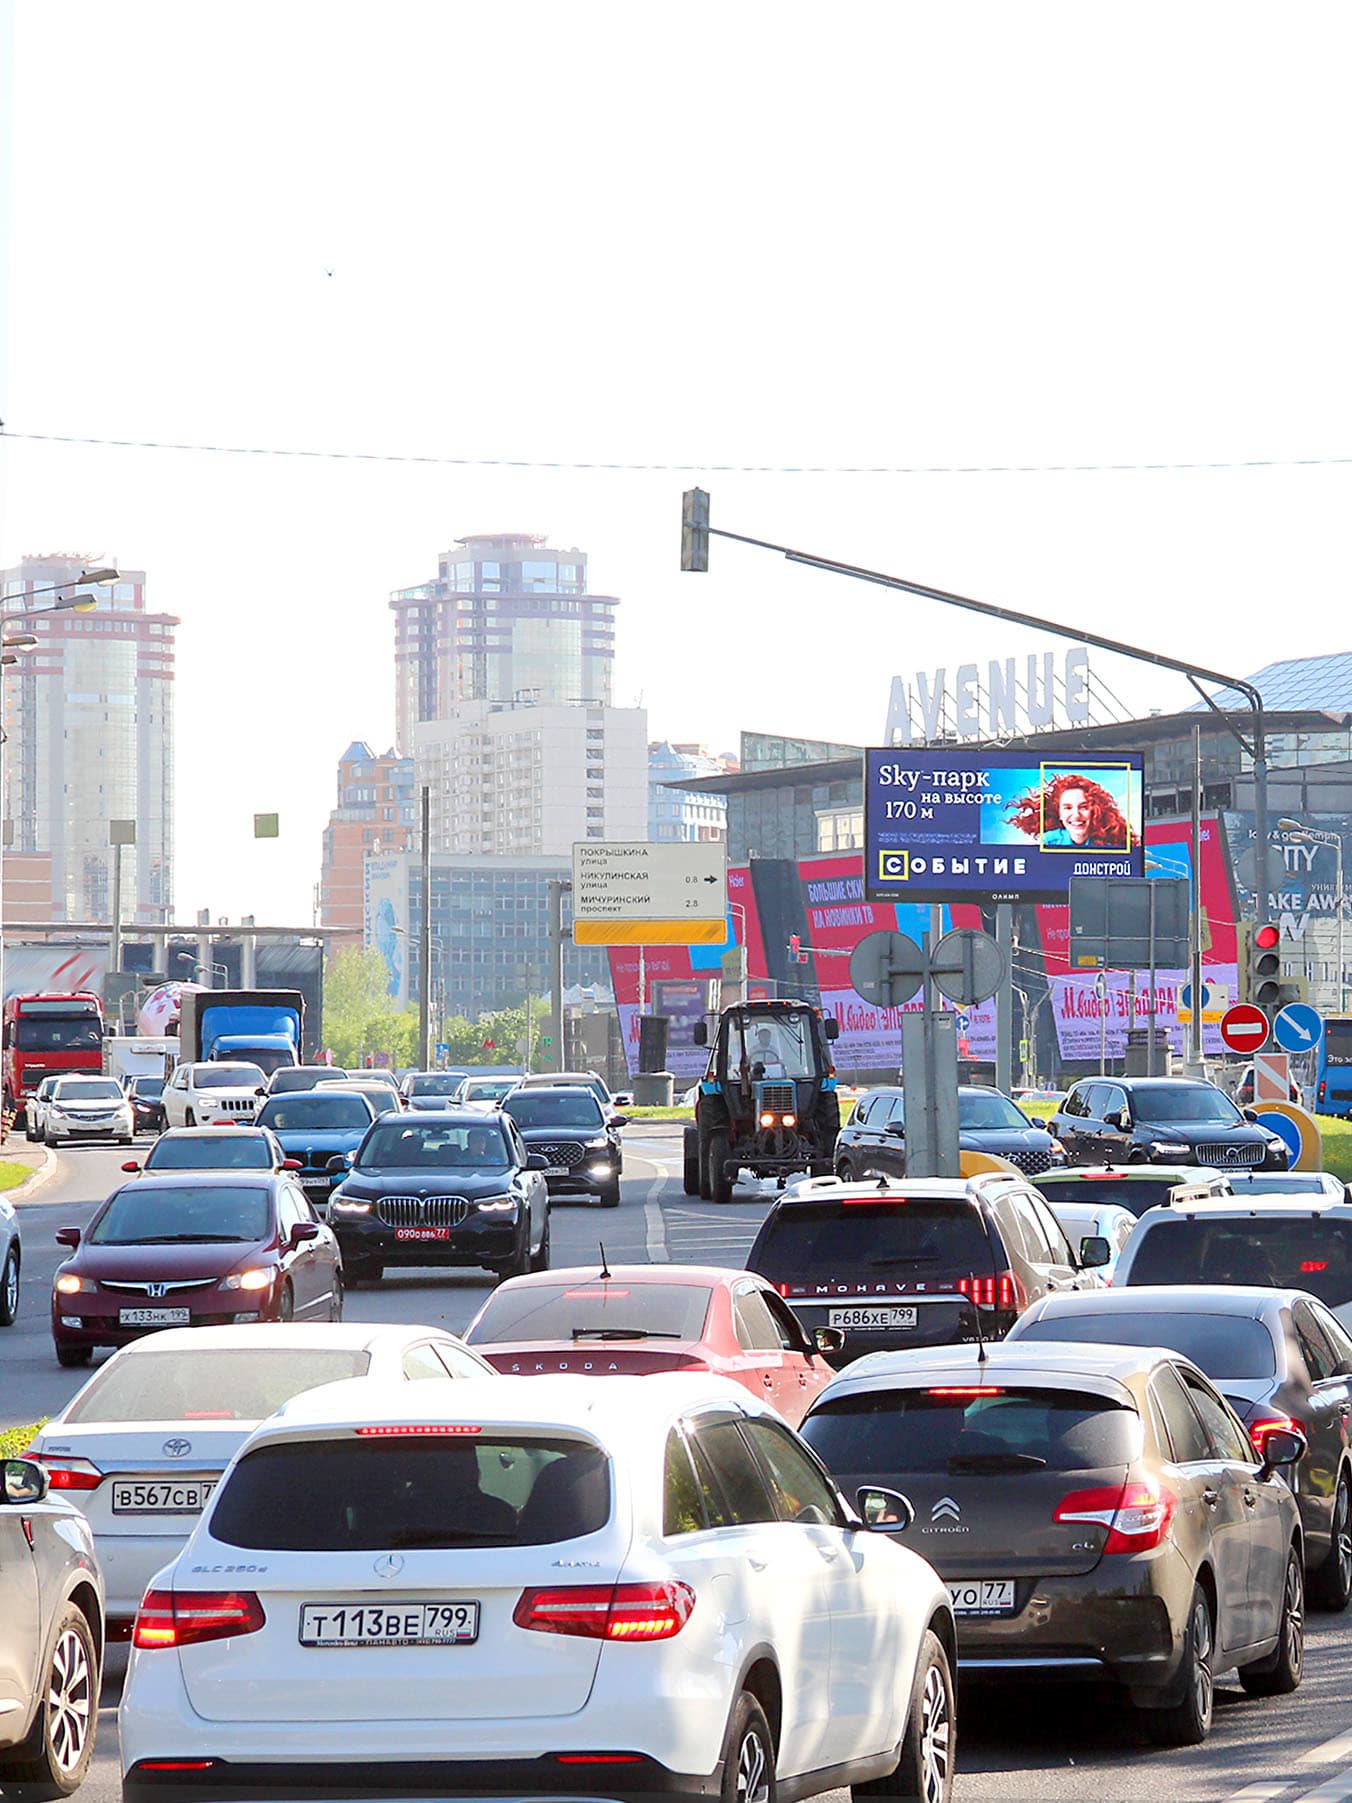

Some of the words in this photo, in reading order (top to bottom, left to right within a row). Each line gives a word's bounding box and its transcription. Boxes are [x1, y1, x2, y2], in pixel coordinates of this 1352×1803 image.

[884, 647, 1089, 747] AVENUE
[879, 765, 990, 791] Sky-парк
[921, 793, 939, 803] на
[944, 793, 1002, 805] высоте
[885, 802, 917, 819] 170
[921, 808, 934, 819] м
[580, 848, 648, 857] ПОКРЫШКИНА
[1271, 846, 1319, 872] ITY
[886, 857, 1027, 875] СОБЫТИЕ
[1073, 859, 1132, 876] ДОНСТРОЙ
[580, 872, 649, 880] НИКУЛИНСКАЯ
[580, 895, 651, 904] МИЧУРИНСКИЙ
[808, 882, 846, 903] БОЛЬШИЕ
[992, 892, 1020, 900] ОЛИМП
[580, 905, 622, 913] проспект
[1328, 1054, 1343, 1063] Это
[816, 1283, 926, 1293] MOHAVE
[833, 1311, 889, 1325] Р686ХЕ
[891, 1309, 914, 1320] 799
[119, 1486, 198, 1506] В567СВ
[984, 1582, 1007, 1600] 77
[312, 1609, 420, 1638] Т113ВЕ
[427, 1607, 468, 1628] 799
[434, 1628, 455, 1637] RUS
